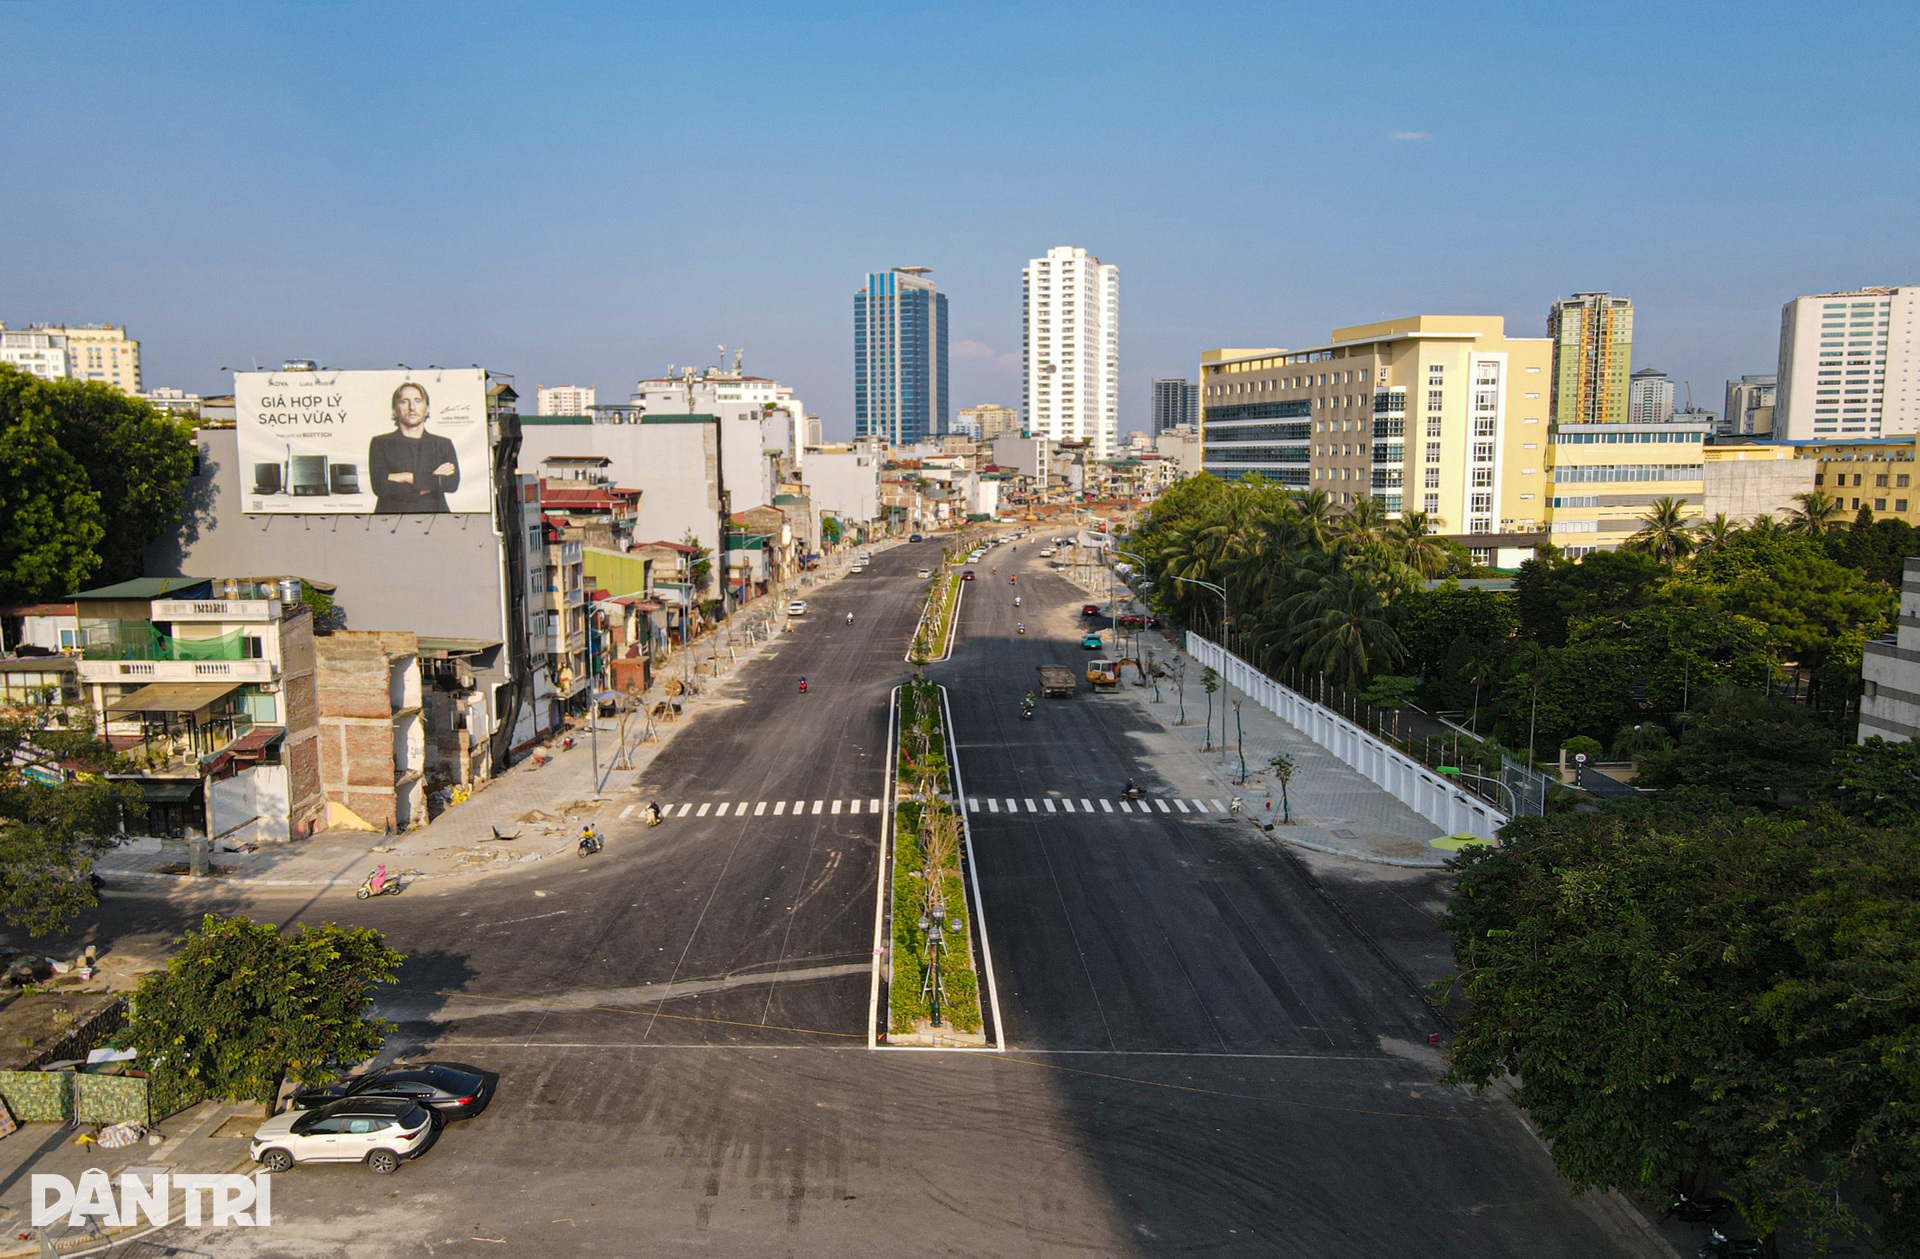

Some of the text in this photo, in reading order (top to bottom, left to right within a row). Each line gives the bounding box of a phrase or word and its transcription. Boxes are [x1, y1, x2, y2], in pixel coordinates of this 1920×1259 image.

[261, 393, 342, 411] GIÁ HỢP LÝ
[258, 409, 347, 427] SẠCH VỪA Ý
